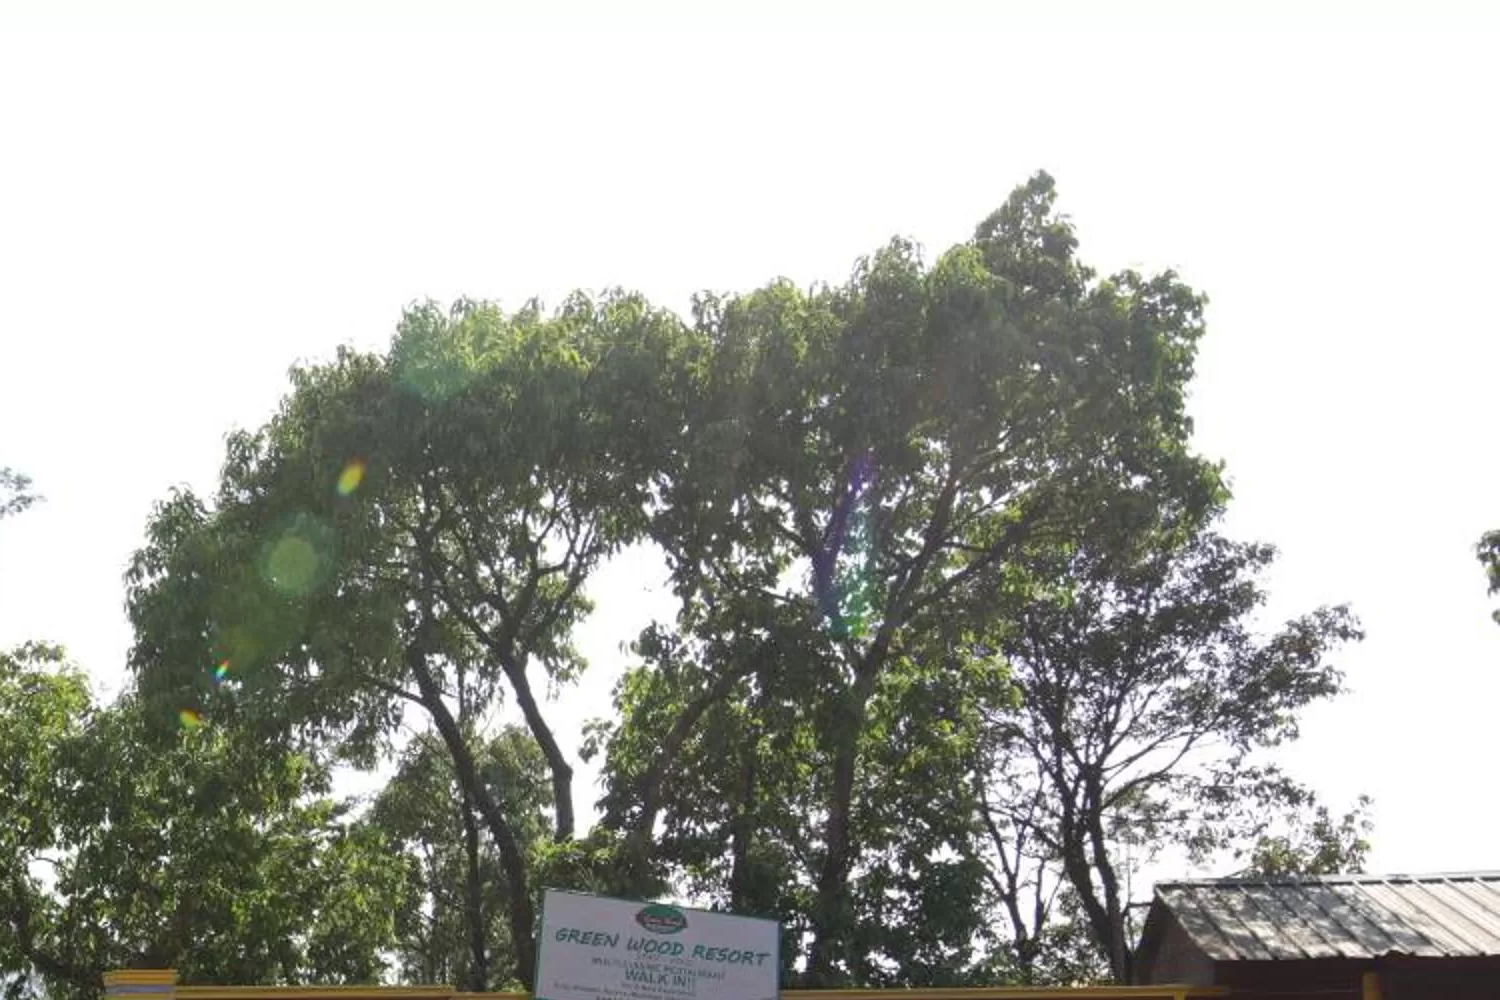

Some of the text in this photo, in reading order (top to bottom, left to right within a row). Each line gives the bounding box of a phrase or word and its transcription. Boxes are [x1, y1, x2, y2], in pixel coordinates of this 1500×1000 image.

[555, 927, 619, 948] GREEN
[626, 936, 684, 956] WOOD
[692, 944, 770, 966] RESORT
[625, 968, 668, 985] WALK
